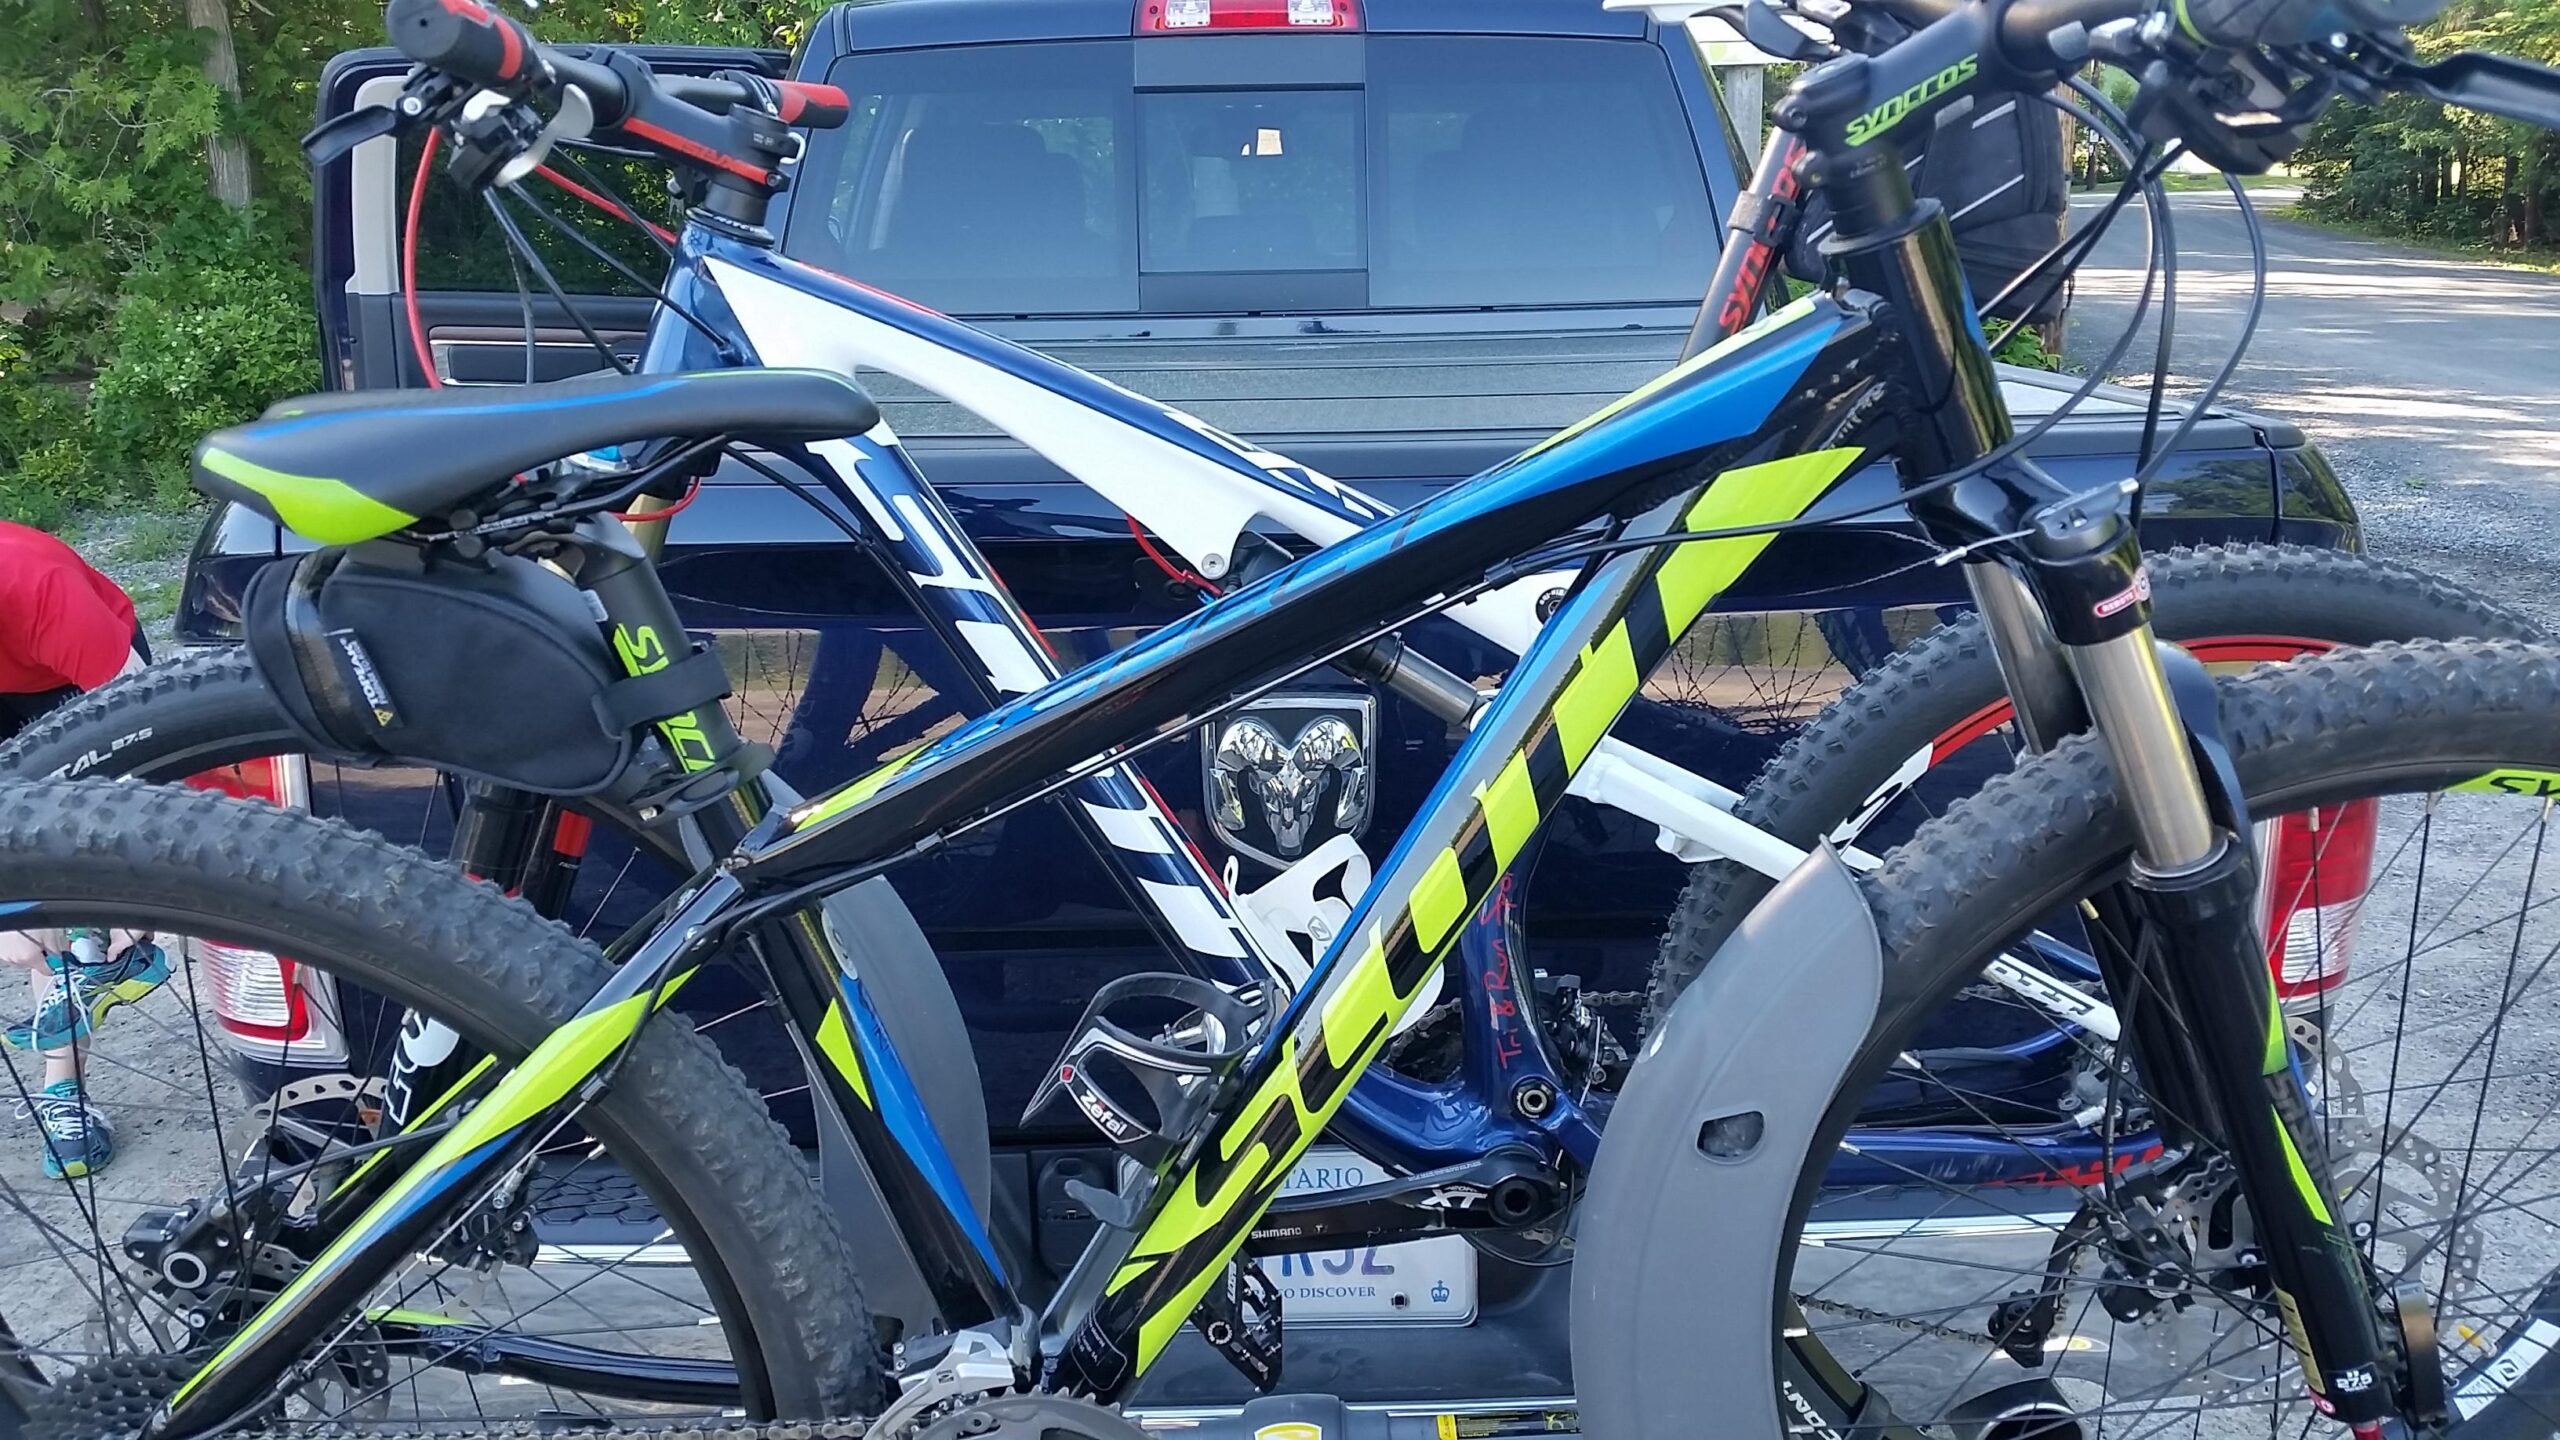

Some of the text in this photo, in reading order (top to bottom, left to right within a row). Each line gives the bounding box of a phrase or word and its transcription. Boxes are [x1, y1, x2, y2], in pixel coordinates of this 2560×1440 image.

[1845, 52, 1979, 147] SYNCROS
[1483, 938, 1511, 991] Run
[1488, 997, 1517, 1017] &
[1496, 1028, 1522, 1070] Tri
[1421, 1188, 1488, 1209] XT
[1251, 1226, 1302, 1240] SHIMANO
[1300, 1284, 1376, 1299] DISCOVER
